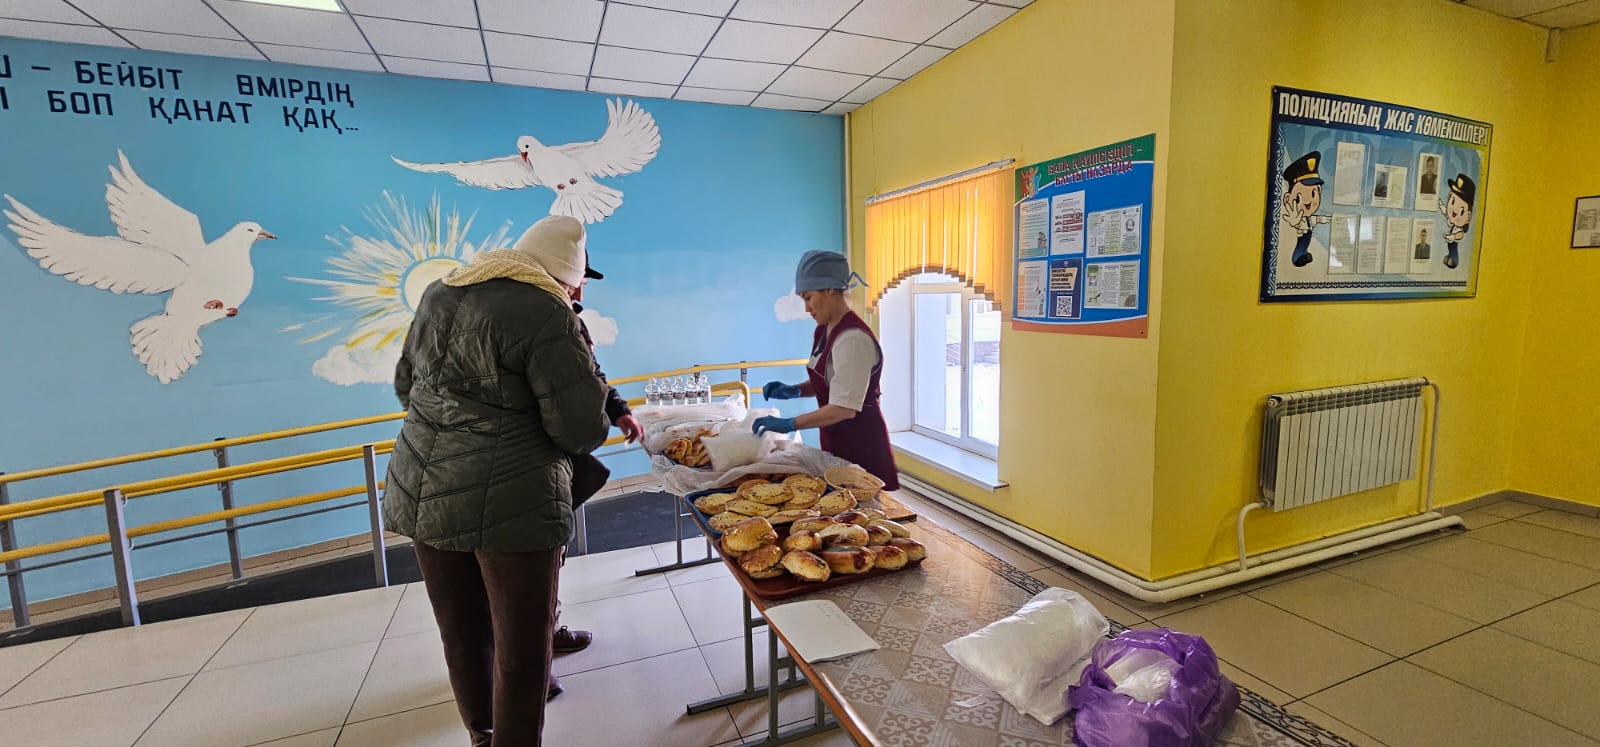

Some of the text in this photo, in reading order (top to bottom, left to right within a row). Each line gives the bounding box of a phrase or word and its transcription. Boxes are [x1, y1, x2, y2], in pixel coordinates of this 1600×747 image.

[75, 61, 183, 90] БЕЙБІТ
[237, 74, 354, 108] ӨМІРДІҢ
[48, 90, 115, 116] БОП
[149, 97, 254, 124] ҚАНАТ
[1278, 92, 1489, 146] ПОЛИЦИЯНЫҢ ЖАС КӨМЕКШІЛЕРІ
[1048, 160, 1070, 175] БАЛА
[1055, 160, 1134, 187] БАСТЫ НАЗАРДА
